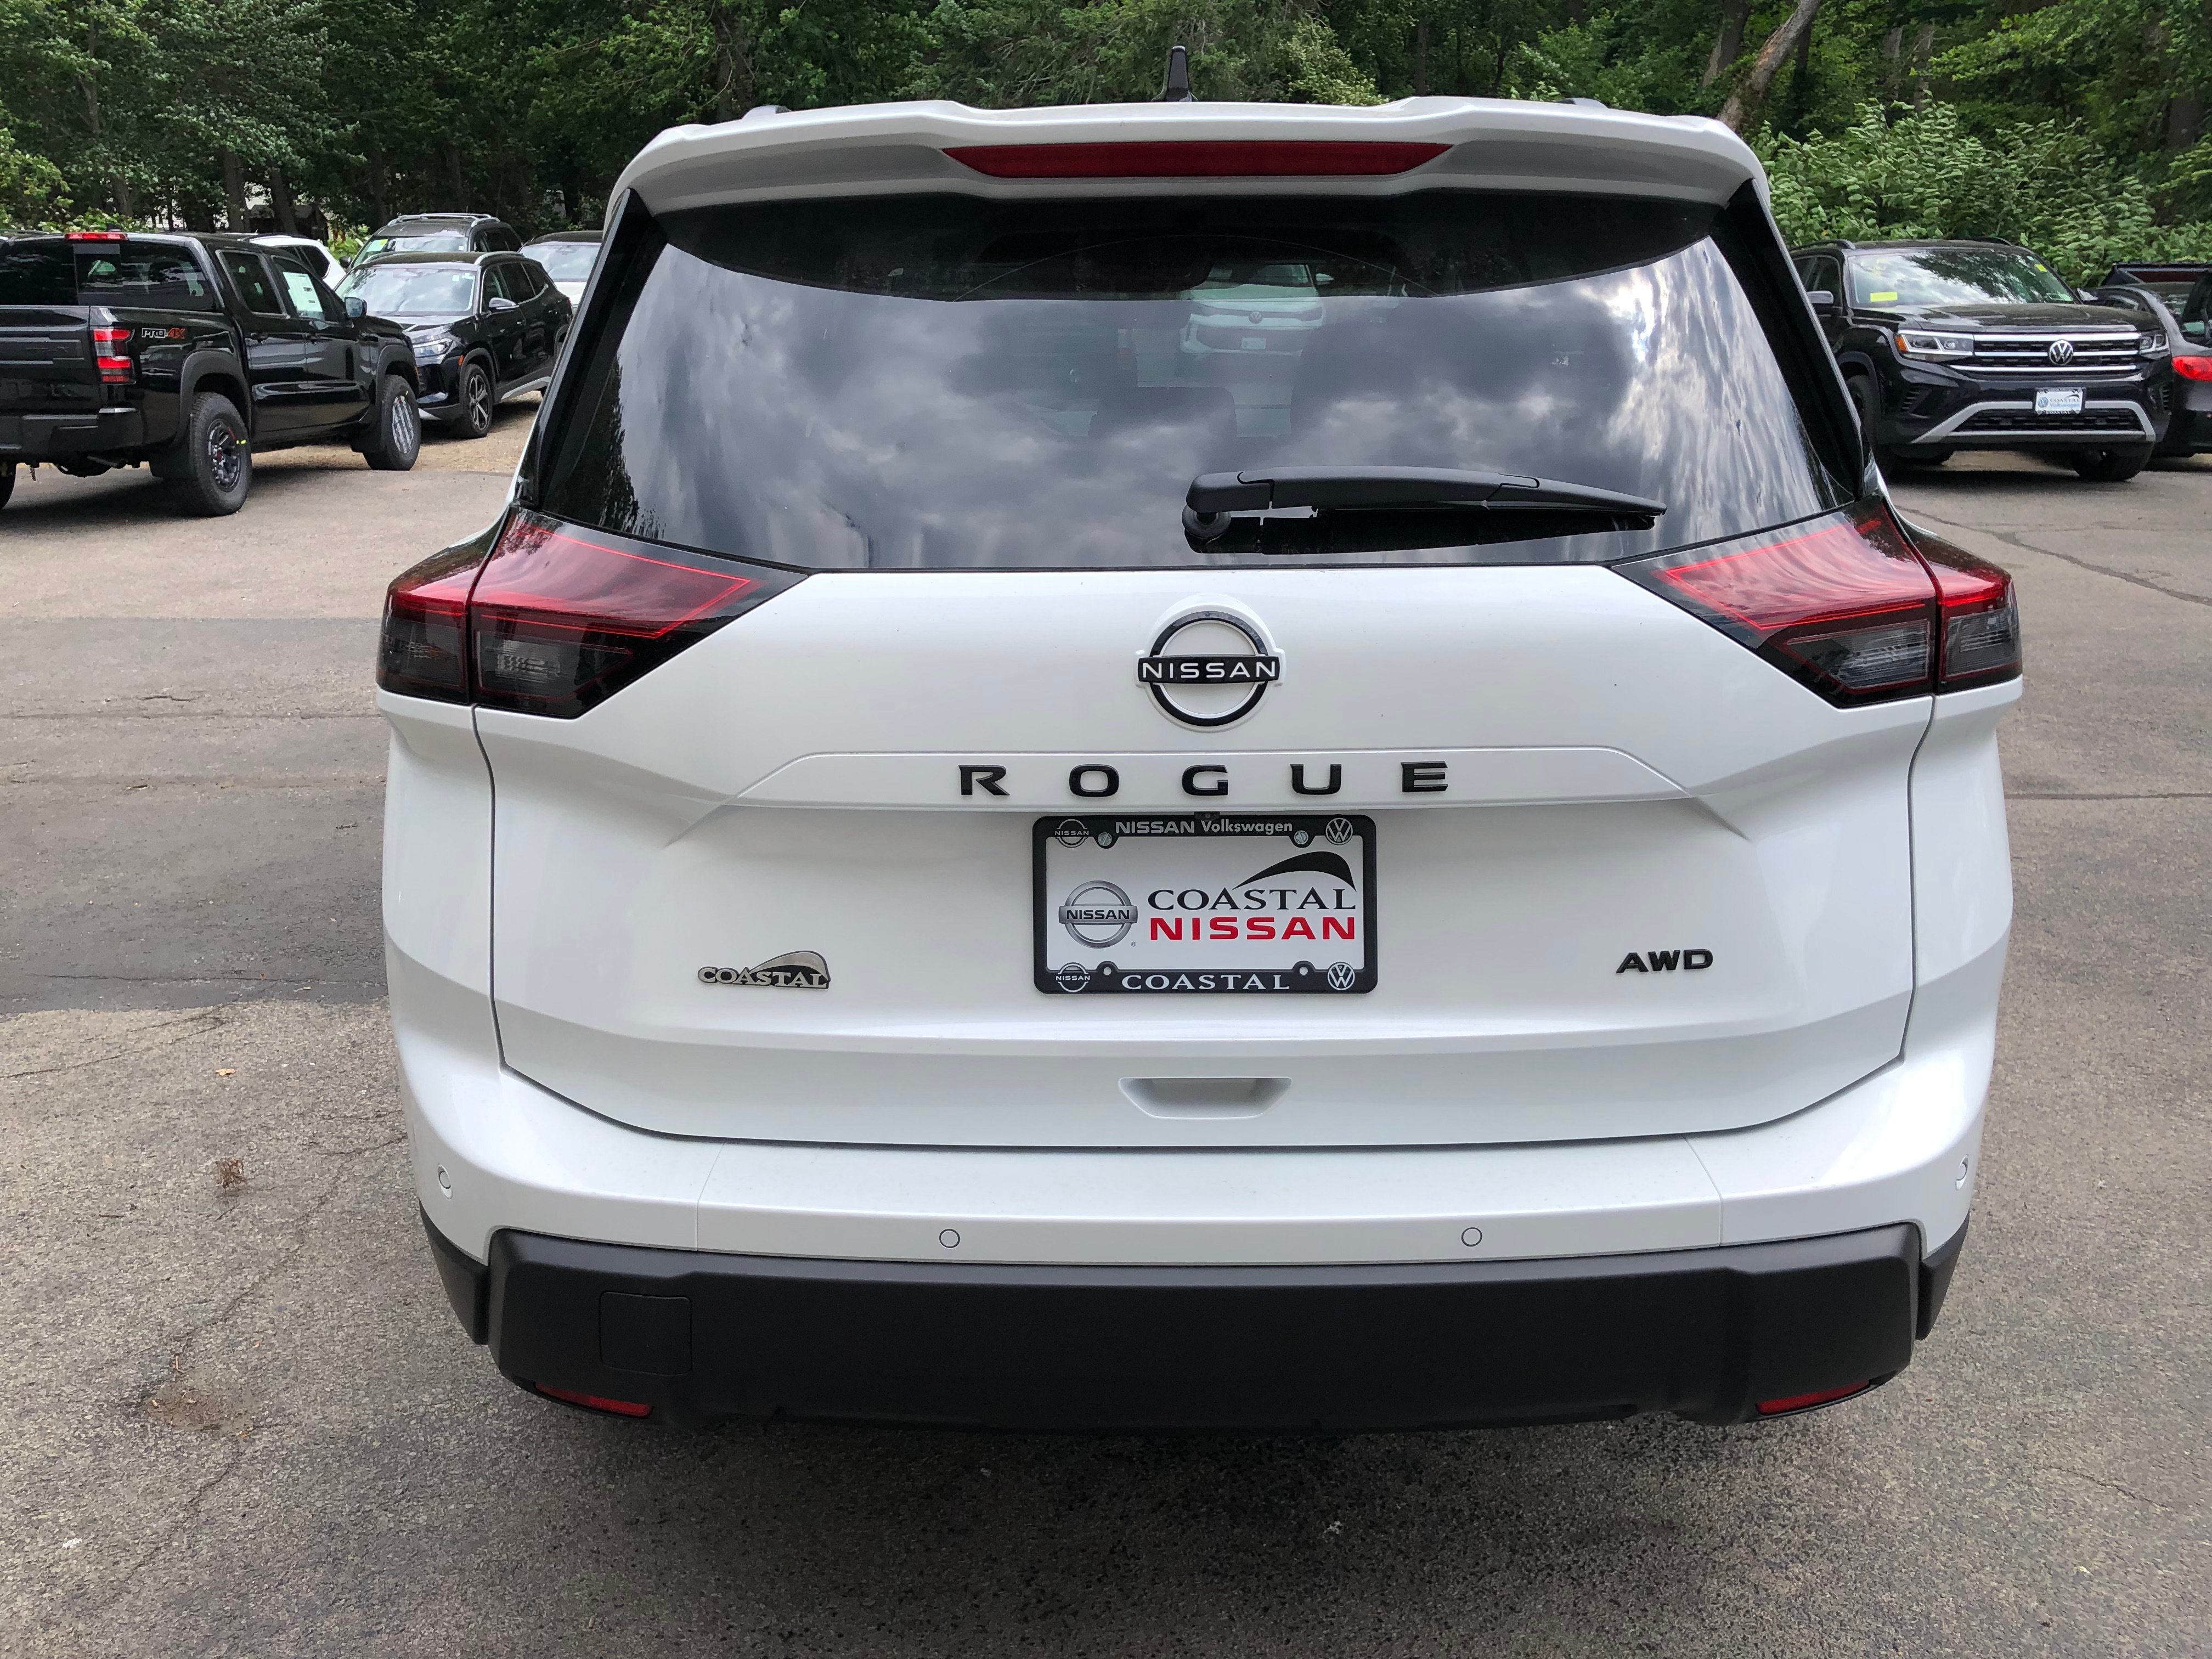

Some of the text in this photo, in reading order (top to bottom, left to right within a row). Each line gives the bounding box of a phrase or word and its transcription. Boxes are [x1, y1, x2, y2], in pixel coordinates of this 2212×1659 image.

[142, 328, 185, 339] PRO-4X
[1142, 660, 1277, 679] NISSAN
[958, 761, 1449, 797] ROGUE
[1054, 828, 1090, 837] NISSAN
[1115, 820, 1293, 835] NISSAN Volkswagen
[1148, 888, 1357, 911] COASTAL
[1066, 909, 1130, 920] NISSAN
[1150, 916, 1355, 940] NISSAN
[1616, 949, 1713, 973] AWD
[697, 967, 828, 989] COASTAL
[1056, 973, 1091, 982] NISSAN
[1122, 974, 1290, 990] COASTAL
